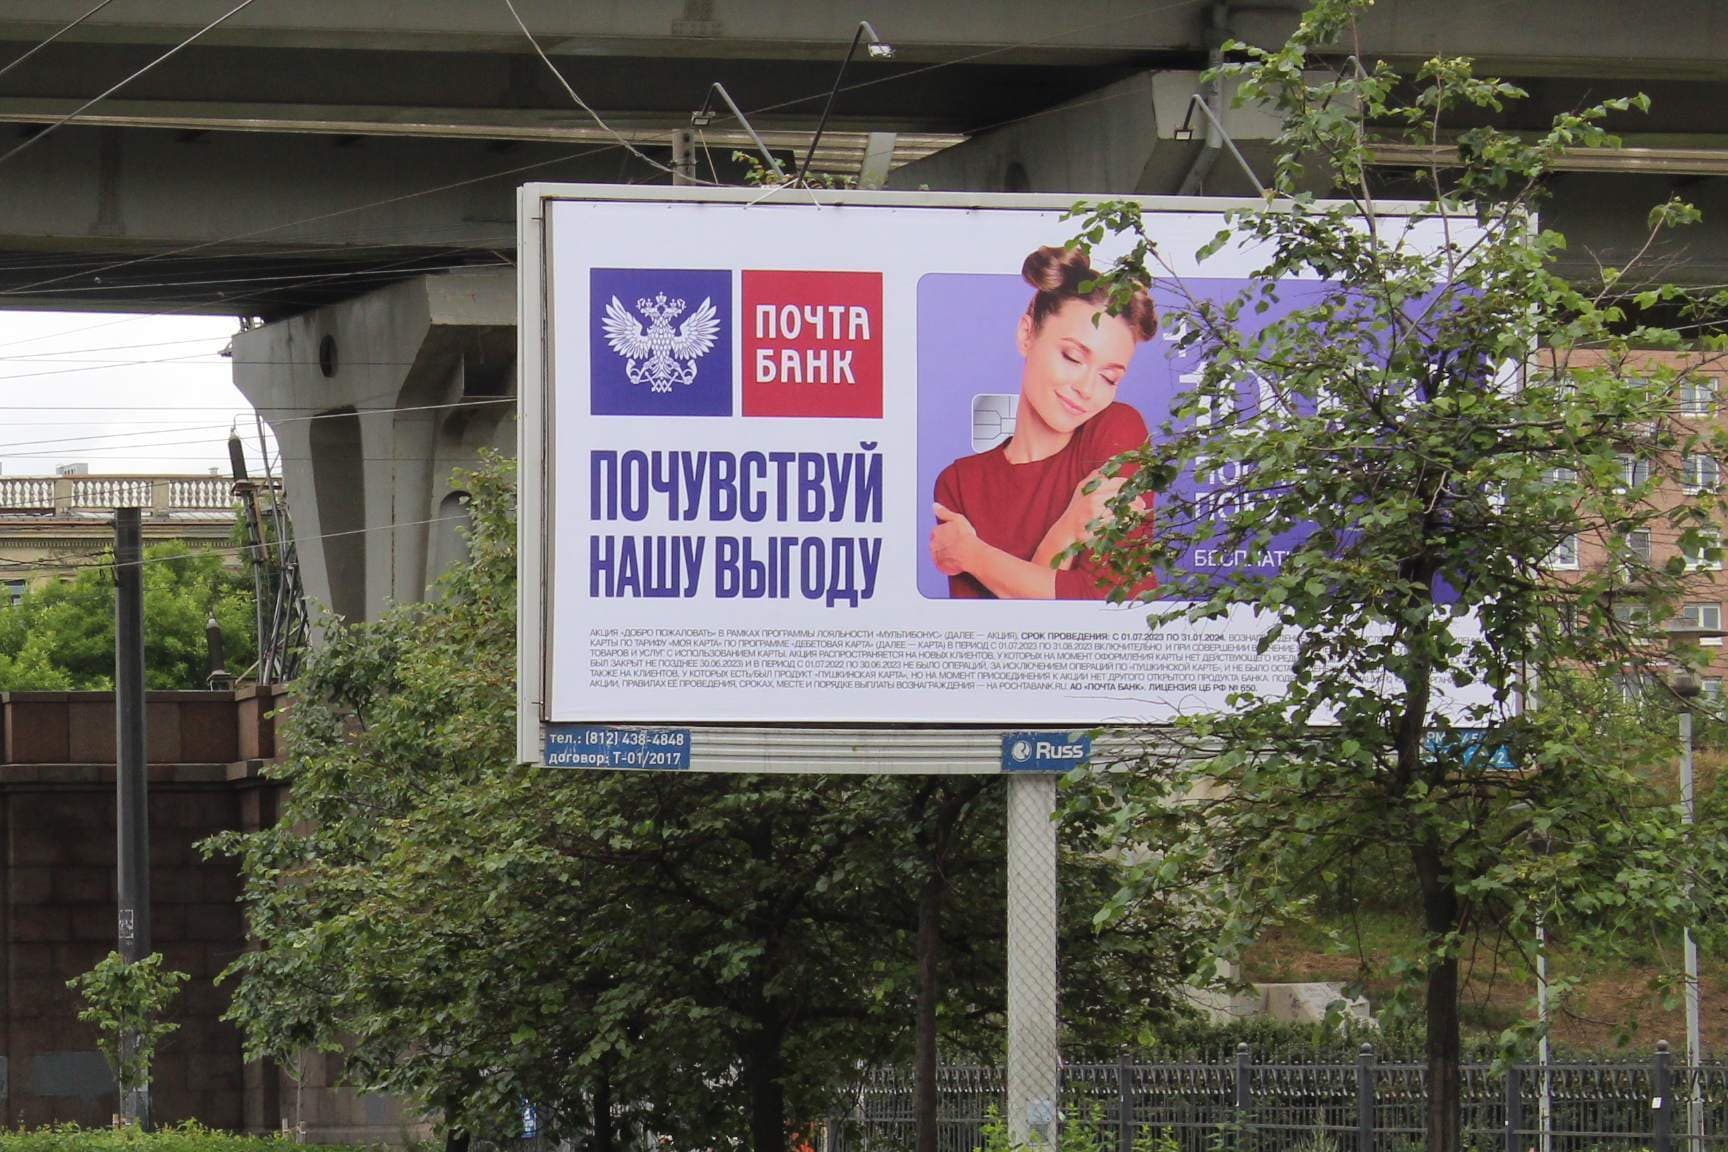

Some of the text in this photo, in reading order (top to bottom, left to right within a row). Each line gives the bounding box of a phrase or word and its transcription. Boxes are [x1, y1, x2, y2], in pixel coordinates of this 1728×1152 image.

[754, 304, 870, 341] ПОЧТА
[755, 348, 856, 385] БАНК
[590, 441, 883, 523] ПОЧУВСТВУЙ
[589, 535, 883, 608] НАШУ ВЫГОДУ
[549, 731, 684, 746] тел.: (812) 438-4848
[1036, 742, 1084, 760] Russ
[549, 754, 609, 766] договор:
